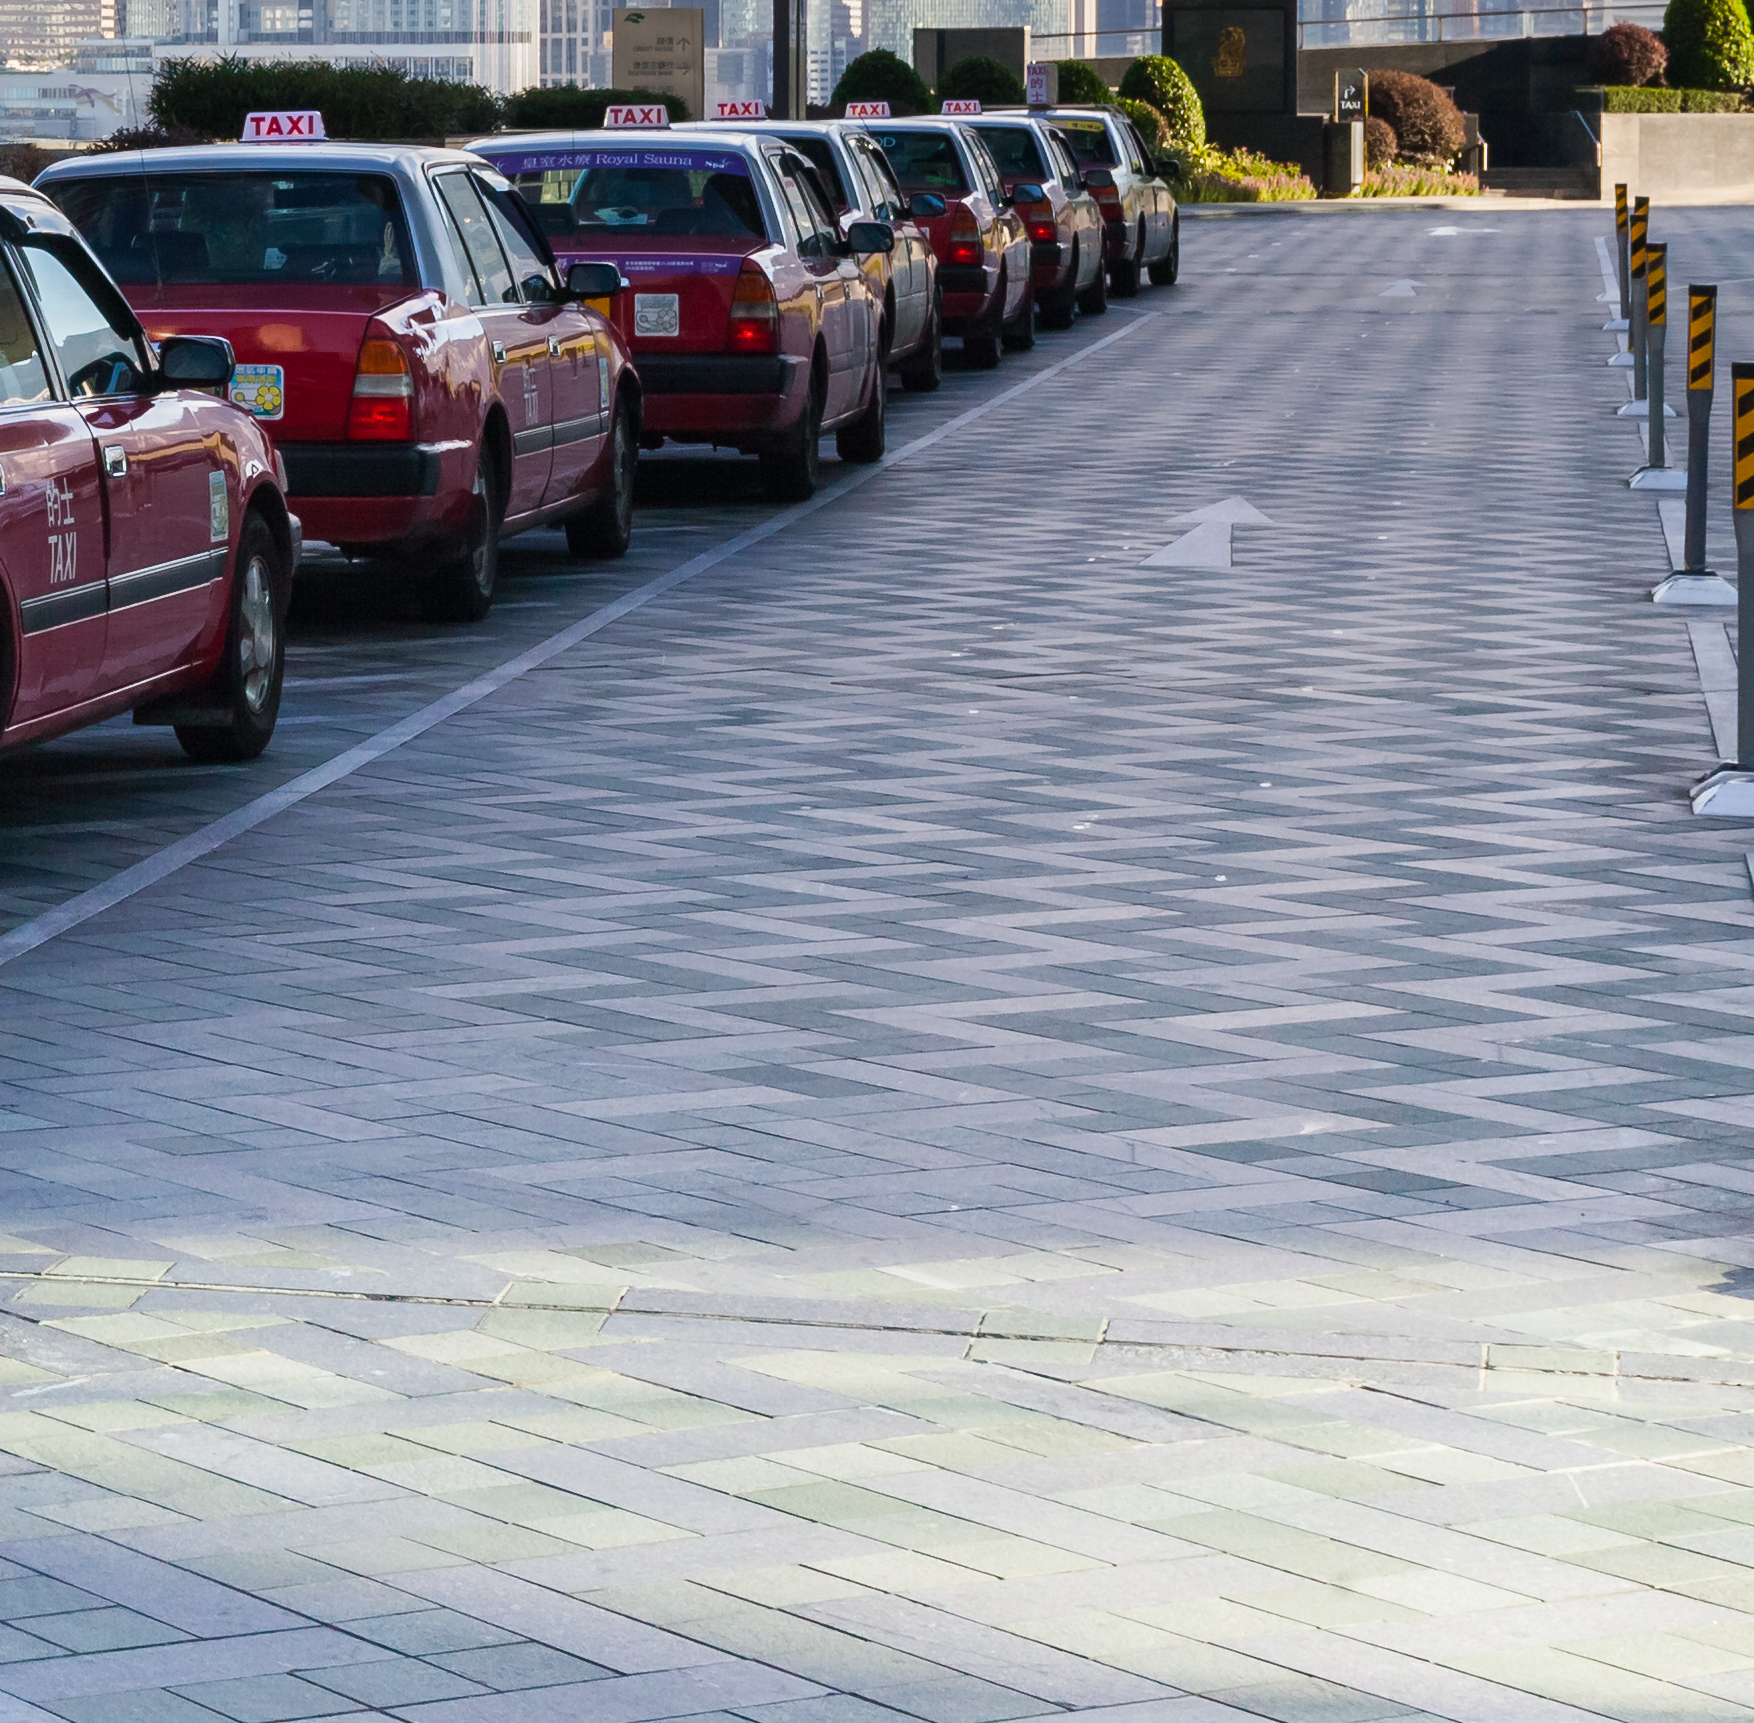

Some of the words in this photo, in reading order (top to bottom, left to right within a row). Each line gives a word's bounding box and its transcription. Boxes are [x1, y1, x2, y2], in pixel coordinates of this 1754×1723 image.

[1026, 64, 1047, 75] TAXI
[1030, 78, 1044, 102] 的士
[717, 102, 760, 116] TAXI
[849, 104, 886, 116] TAXI
[945, 102, 977, 112] TAXI
[610, 108, 662, 124] TAXI
[249, 115, 314, 136] TAXI
[595, 153, 638, 165] Royal
[643, 153, 692, 166] Sauna
[46, 477, 75, 527] 的士
[48, 531, 77, 584] TAXI
